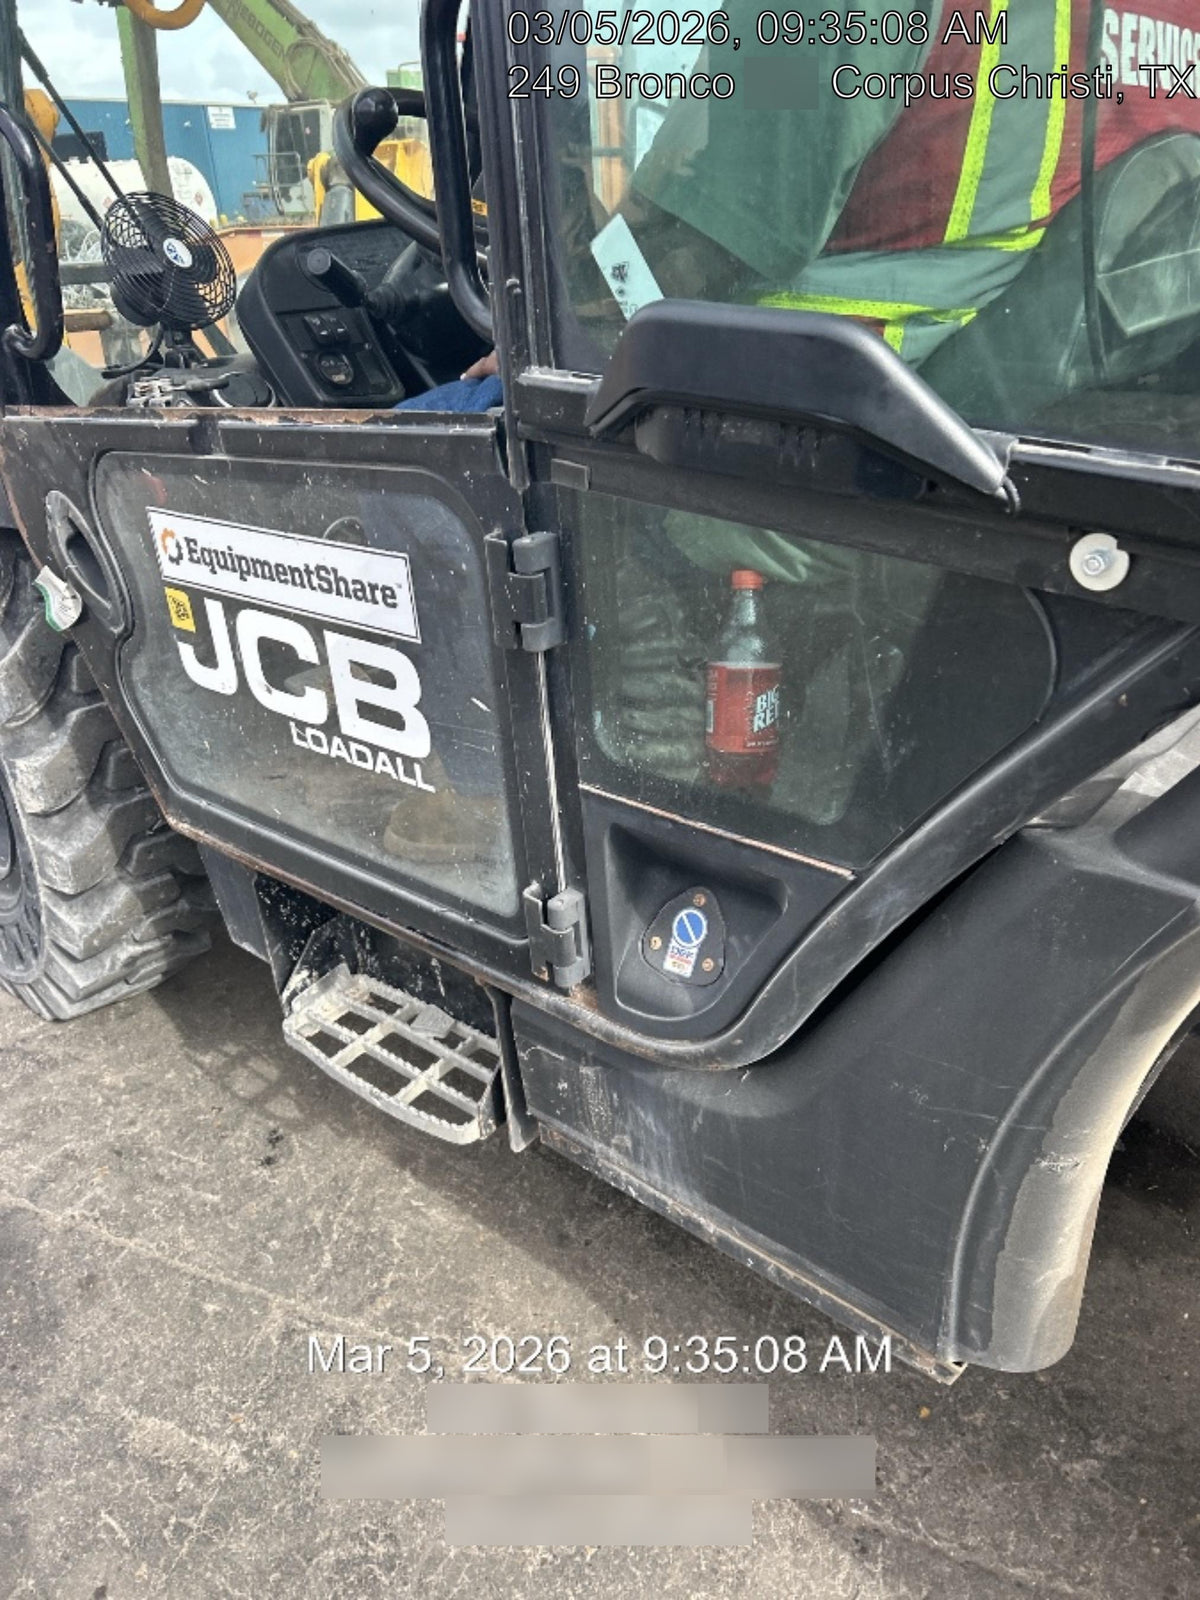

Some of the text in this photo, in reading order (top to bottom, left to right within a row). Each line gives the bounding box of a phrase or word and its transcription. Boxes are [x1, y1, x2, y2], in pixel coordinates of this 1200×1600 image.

[184, 536, 398, 609] EquipmentShare
[173, 597, 431, 759] JCB
[289, 720, 436, 793] LOADALL
